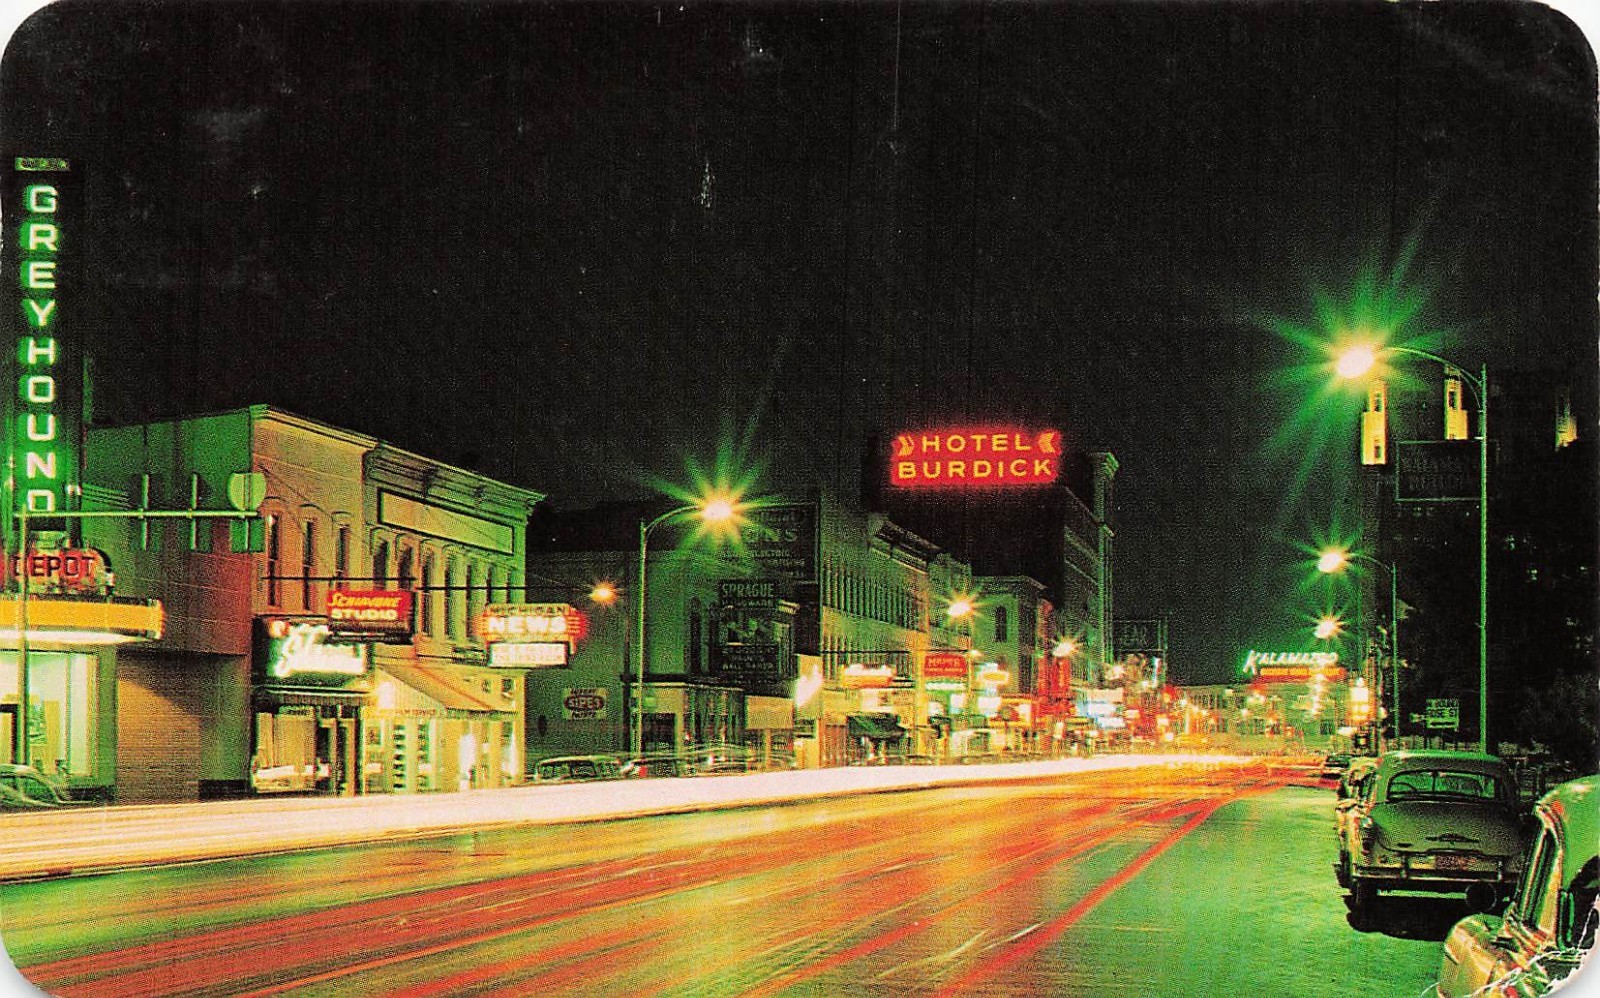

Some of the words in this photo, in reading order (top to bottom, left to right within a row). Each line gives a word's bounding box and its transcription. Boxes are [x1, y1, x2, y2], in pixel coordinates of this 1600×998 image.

[28, 184, 58, 512] GREYHOUND
[921, 433, 1031, 453] HOTEL
[898, 459, 1051, 479] BURDICK
[721, 583, 774, 598] SPRAGUE
[331, 608, 398, 621] STUDIO
[489, 605, 567, 615] MICHIGAN
[488, 616, 567, 633] NEWS
